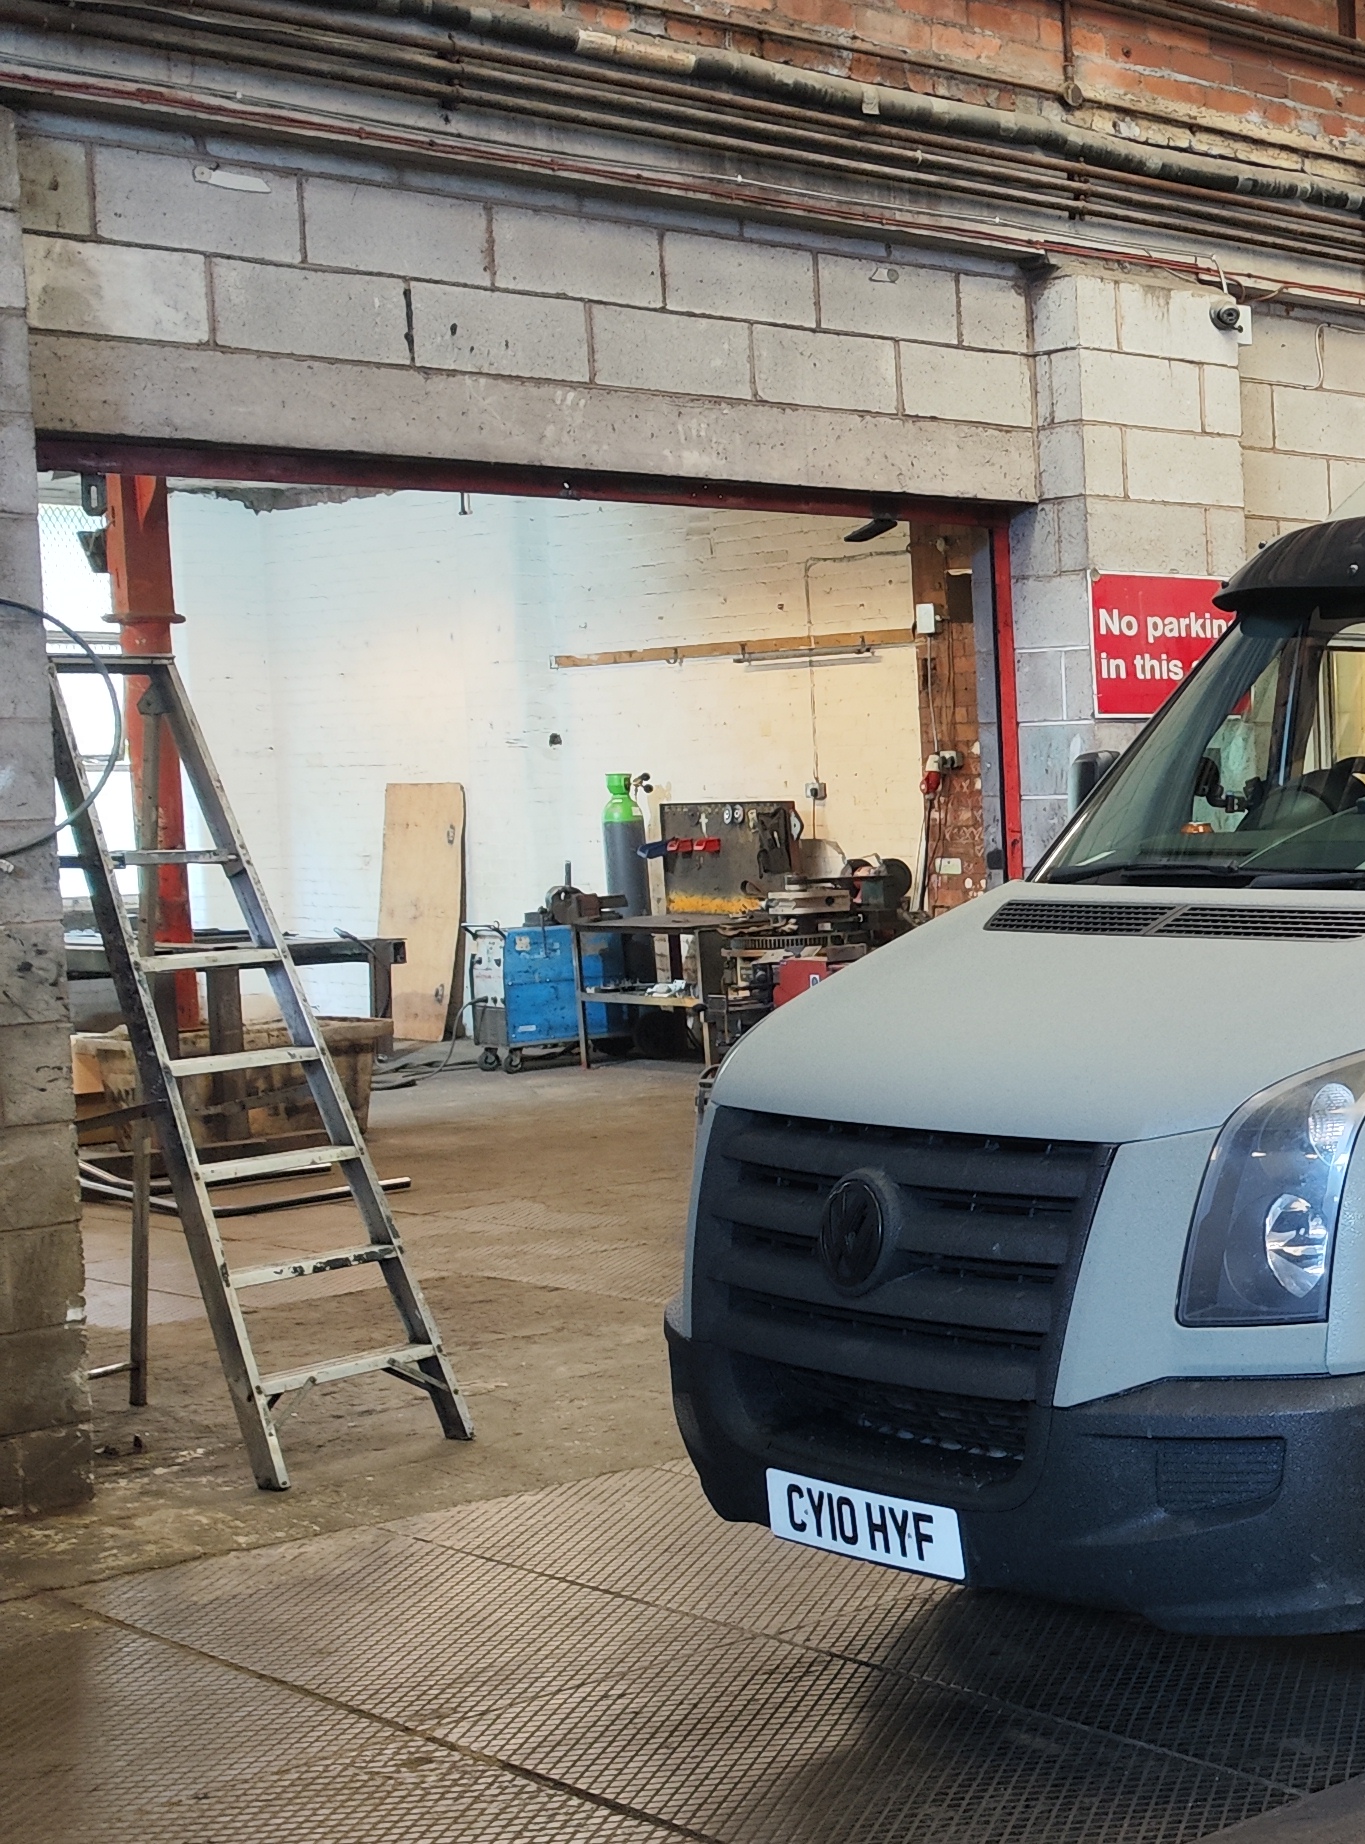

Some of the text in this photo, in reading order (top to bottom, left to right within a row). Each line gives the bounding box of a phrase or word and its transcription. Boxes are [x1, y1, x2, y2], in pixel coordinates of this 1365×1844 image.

[1098, 608, 1138, 637] No
[1100, 652, 1184, 681] in this
[786, 1483, 934, 1562] CY10 HYF
